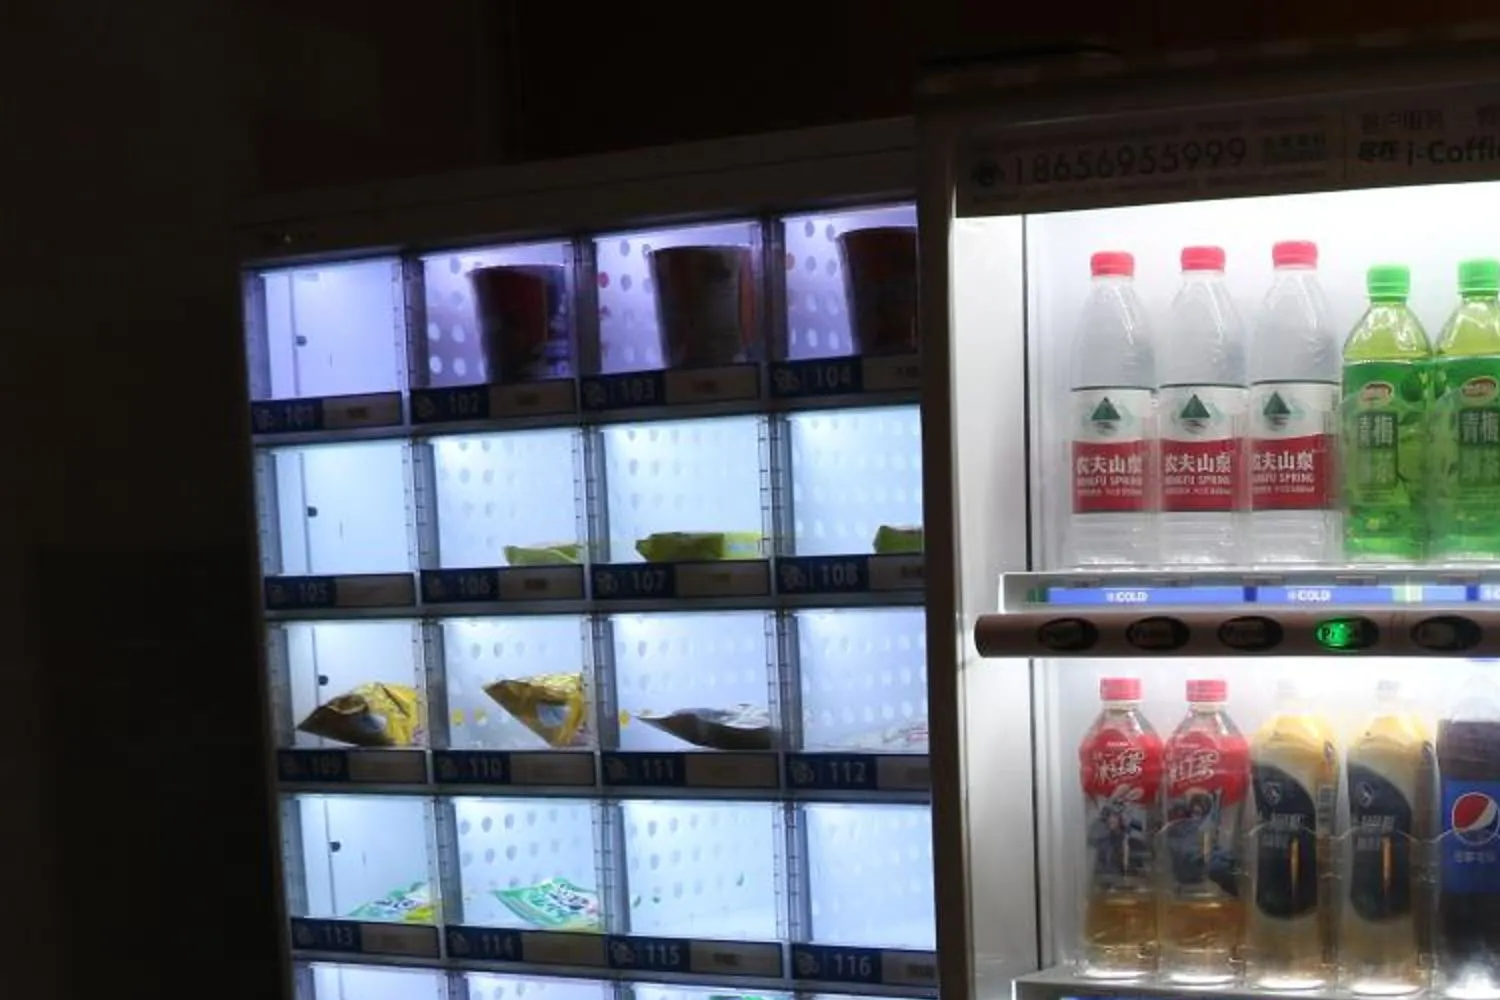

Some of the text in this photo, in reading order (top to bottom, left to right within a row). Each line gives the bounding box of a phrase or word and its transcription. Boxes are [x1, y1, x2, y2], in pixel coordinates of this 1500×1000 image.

[815, 366, 852, 388] 104
[1076, 455, 1143, 475] 农夫山泉
[1165, 453, 1232, 475] 农夫山泉
[631, 570, 666, 590] 107
[820, 563, 859, 586] 108
[830, 760, 865, 783] 112
[646, 943, 680, 965] 115
[835, 953, 872, 978] 116
